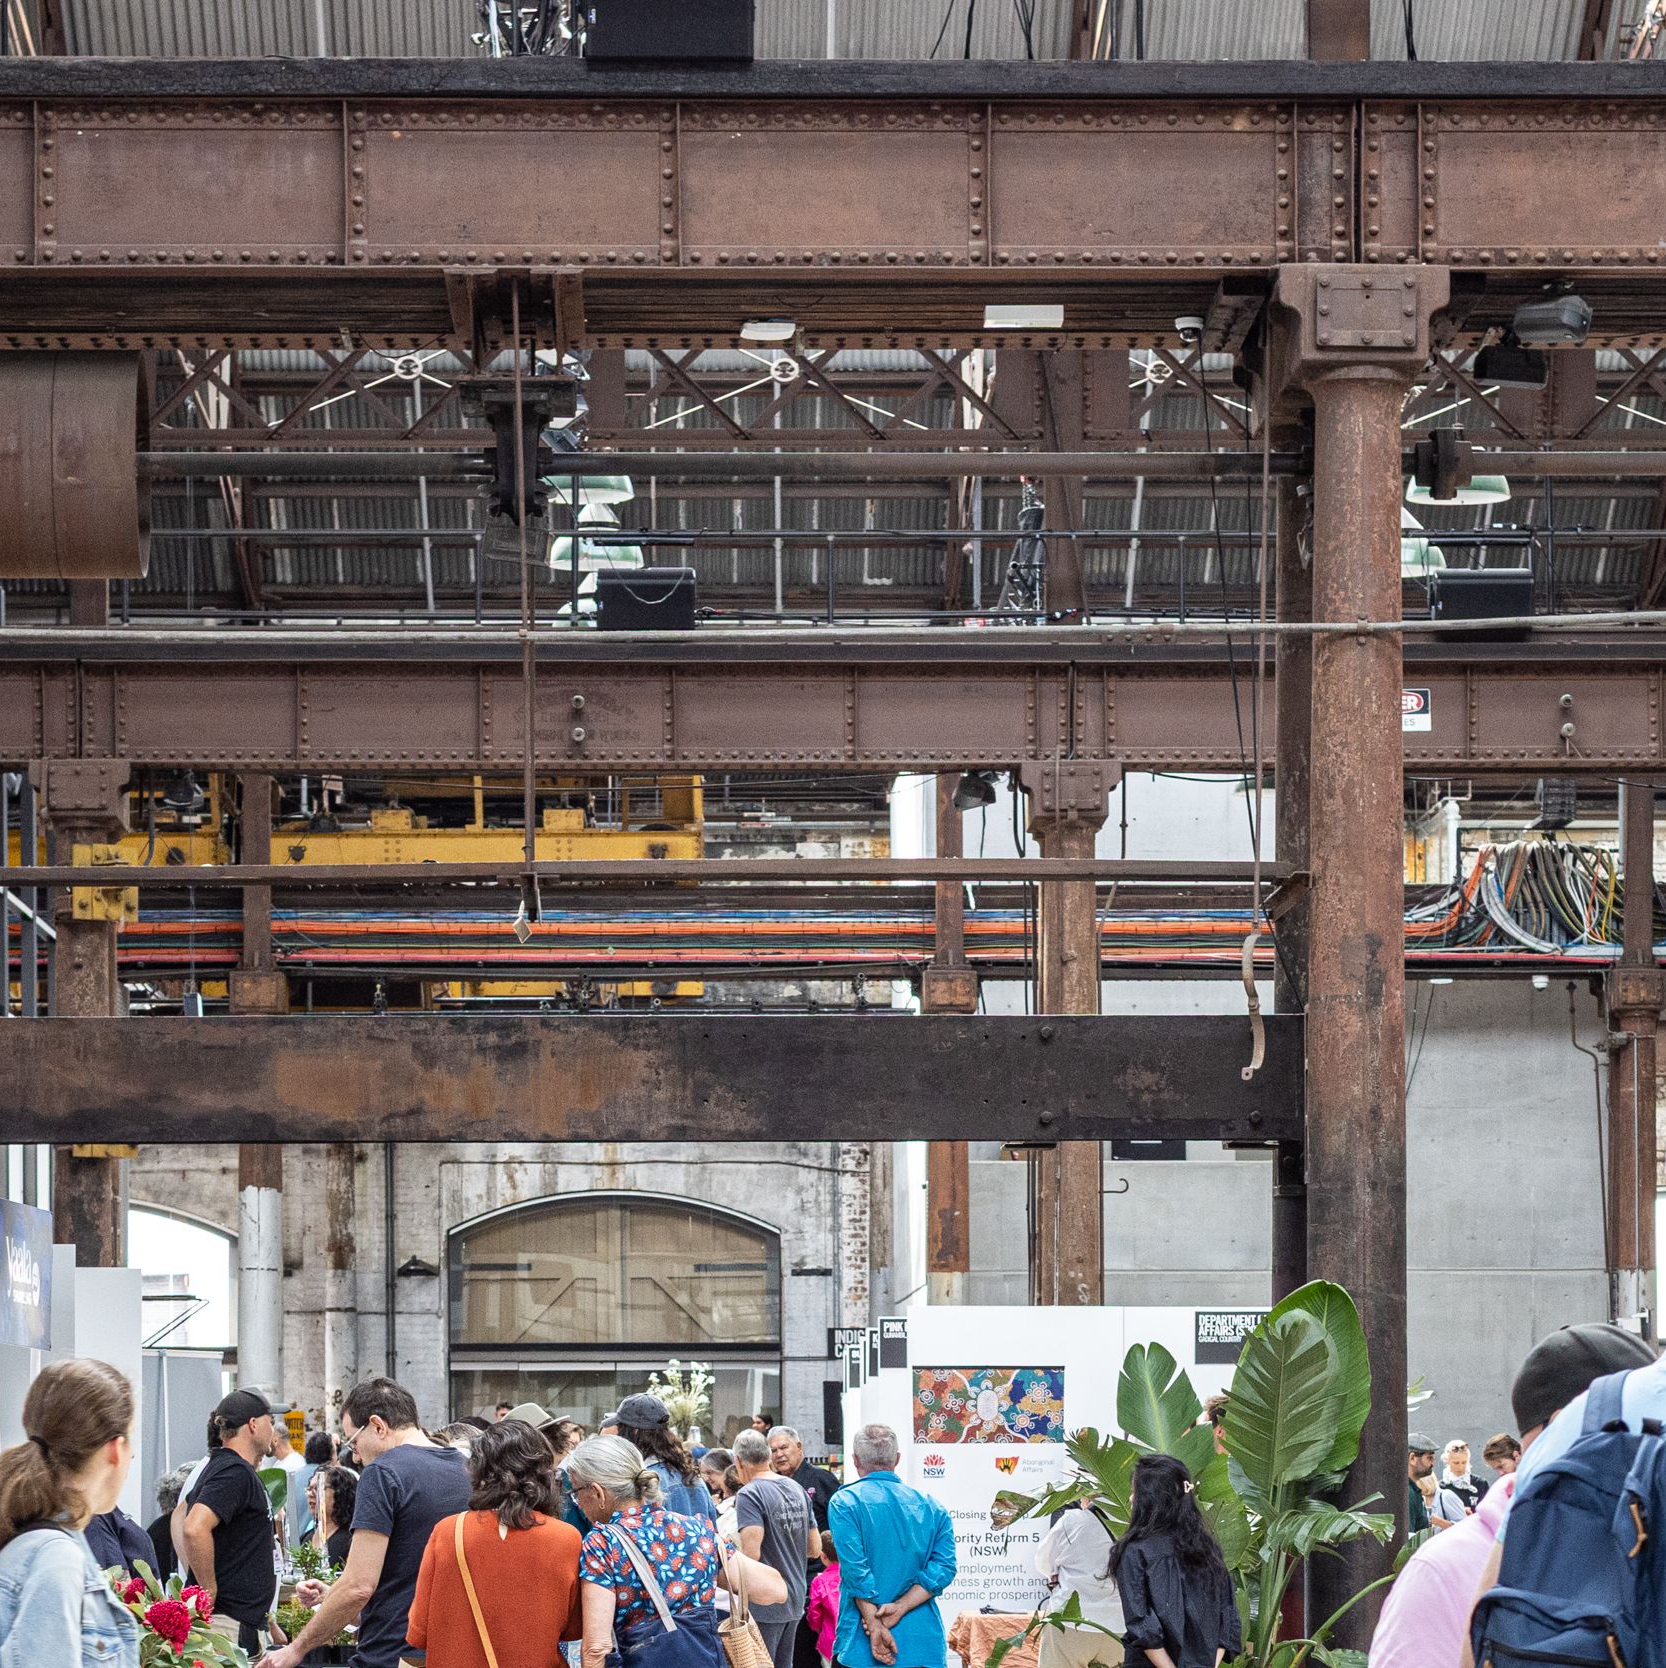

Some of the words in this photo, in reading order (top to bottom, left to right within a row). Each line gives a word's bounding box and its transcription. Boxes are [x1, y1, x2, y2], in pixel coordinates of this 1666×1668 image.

[1197, 1314, 1257, 1326] DEPARTMENT
[883, 1321, 904, 1333] PINK
[1197, 1325, 1235, 1337] AFFAIRS
[1022, 1459, 1055, 1467] Aboriginal
[923, 1467, 946, 1476] NSW
[949, 1510, 987, 1521] Closing
[953, 1532, 982, 1545] ority
[985, 1532, 1029, 1544] Reform
[1032, 1532, 1041, 1544] 5
[969, 1545, 1008, 1558] (NSW)
[957, 1564, 1028, 1576] mployment,
[983, 1576, 1025, 1589] growth
[938, 1589, 985, 1602] conomic
[989, 1589, 1050, 1602] prosperity
